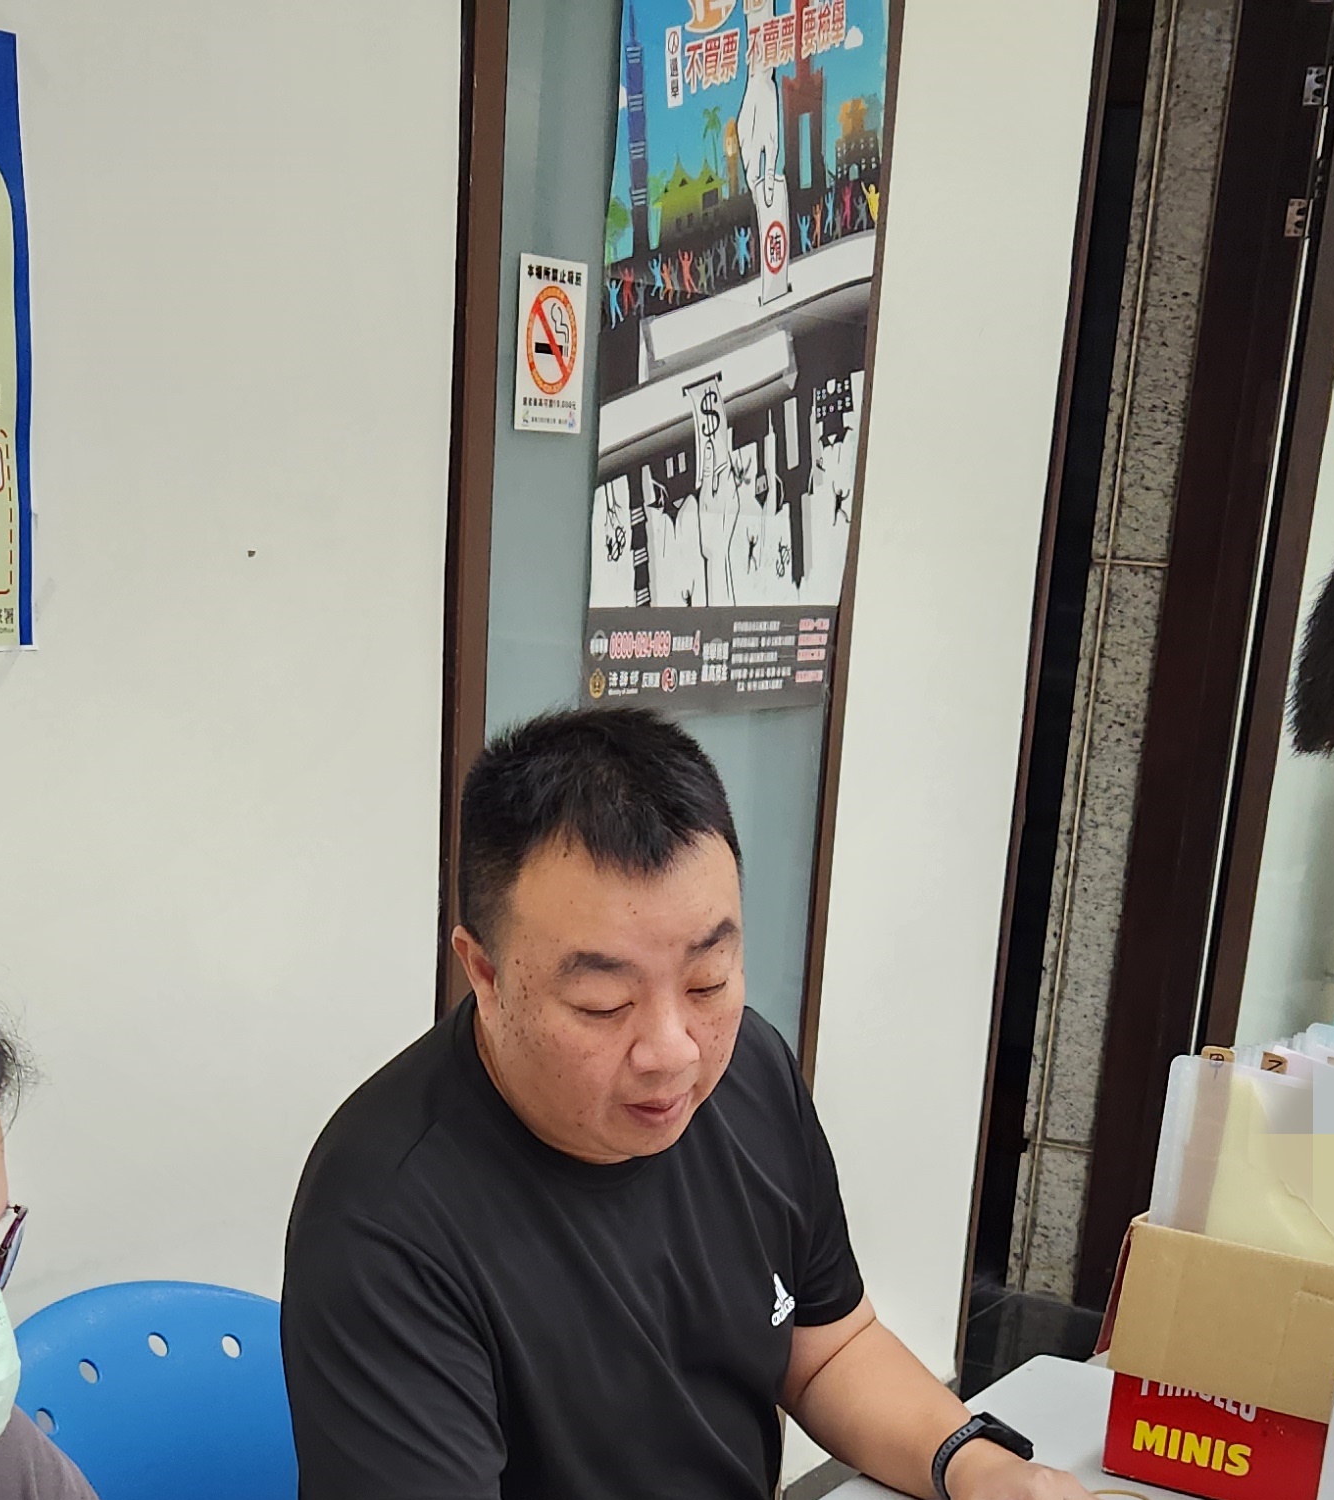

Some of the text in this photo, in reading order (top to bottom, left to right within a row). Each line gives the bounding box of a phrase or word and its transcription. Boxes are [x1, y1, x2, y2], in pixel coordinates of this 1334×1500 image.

[685, 30, 739, 92] 不買票
[747, 14, 796, 70] 不賣票
[1132, 1419, 1252, 1477] MINIS
